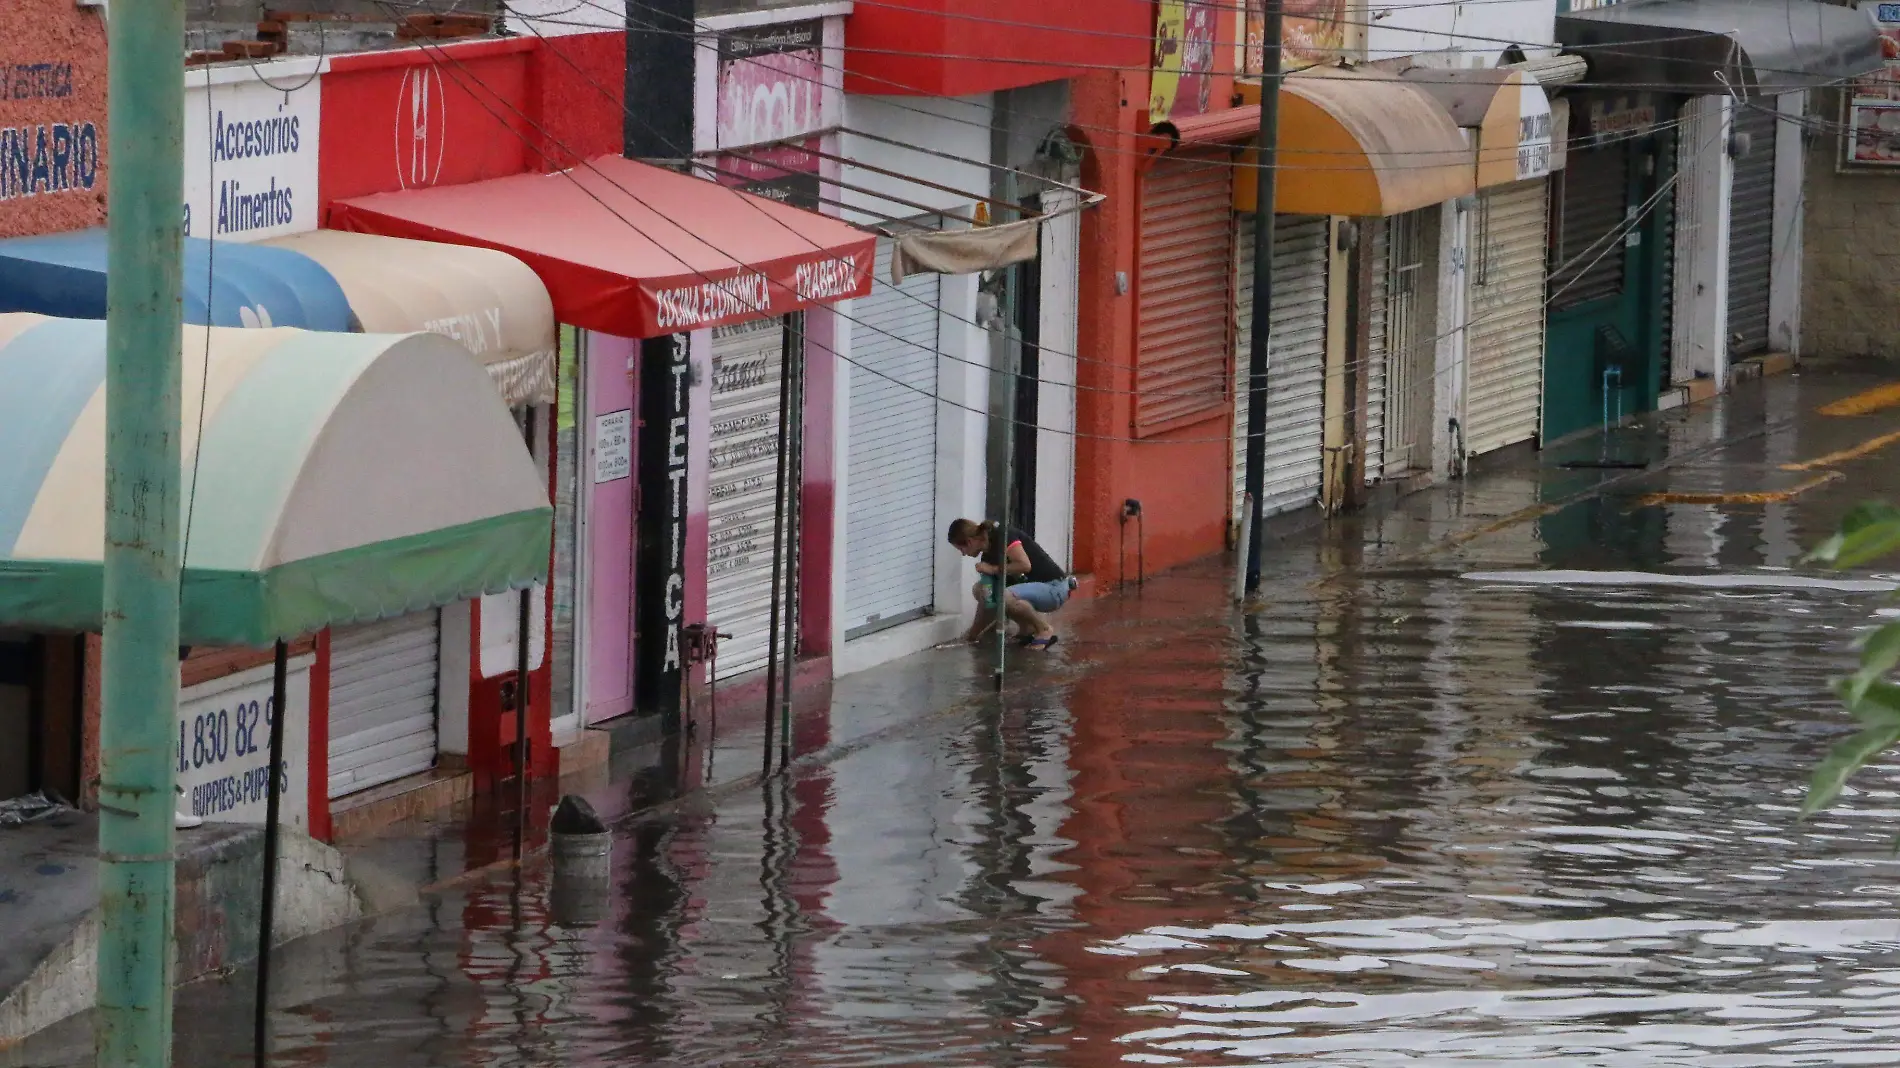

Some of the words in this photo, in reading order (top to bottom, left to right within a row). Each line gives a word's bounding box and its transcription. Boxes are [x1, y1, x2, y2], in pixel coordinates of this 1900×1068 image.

[0, 122, 97, 199] INARIO
[214, 104, 299, 162] Accesorios
[217, 176, 293, 234] Alimentos
[656, 285, 701, 328] COCINA
[702, 266, 770, 322] ECONÓMICA
[796, 255, 857, 302] CHABELITA
[193, 709, 229, 769] 830
[235, 700, 259, 757] 82
